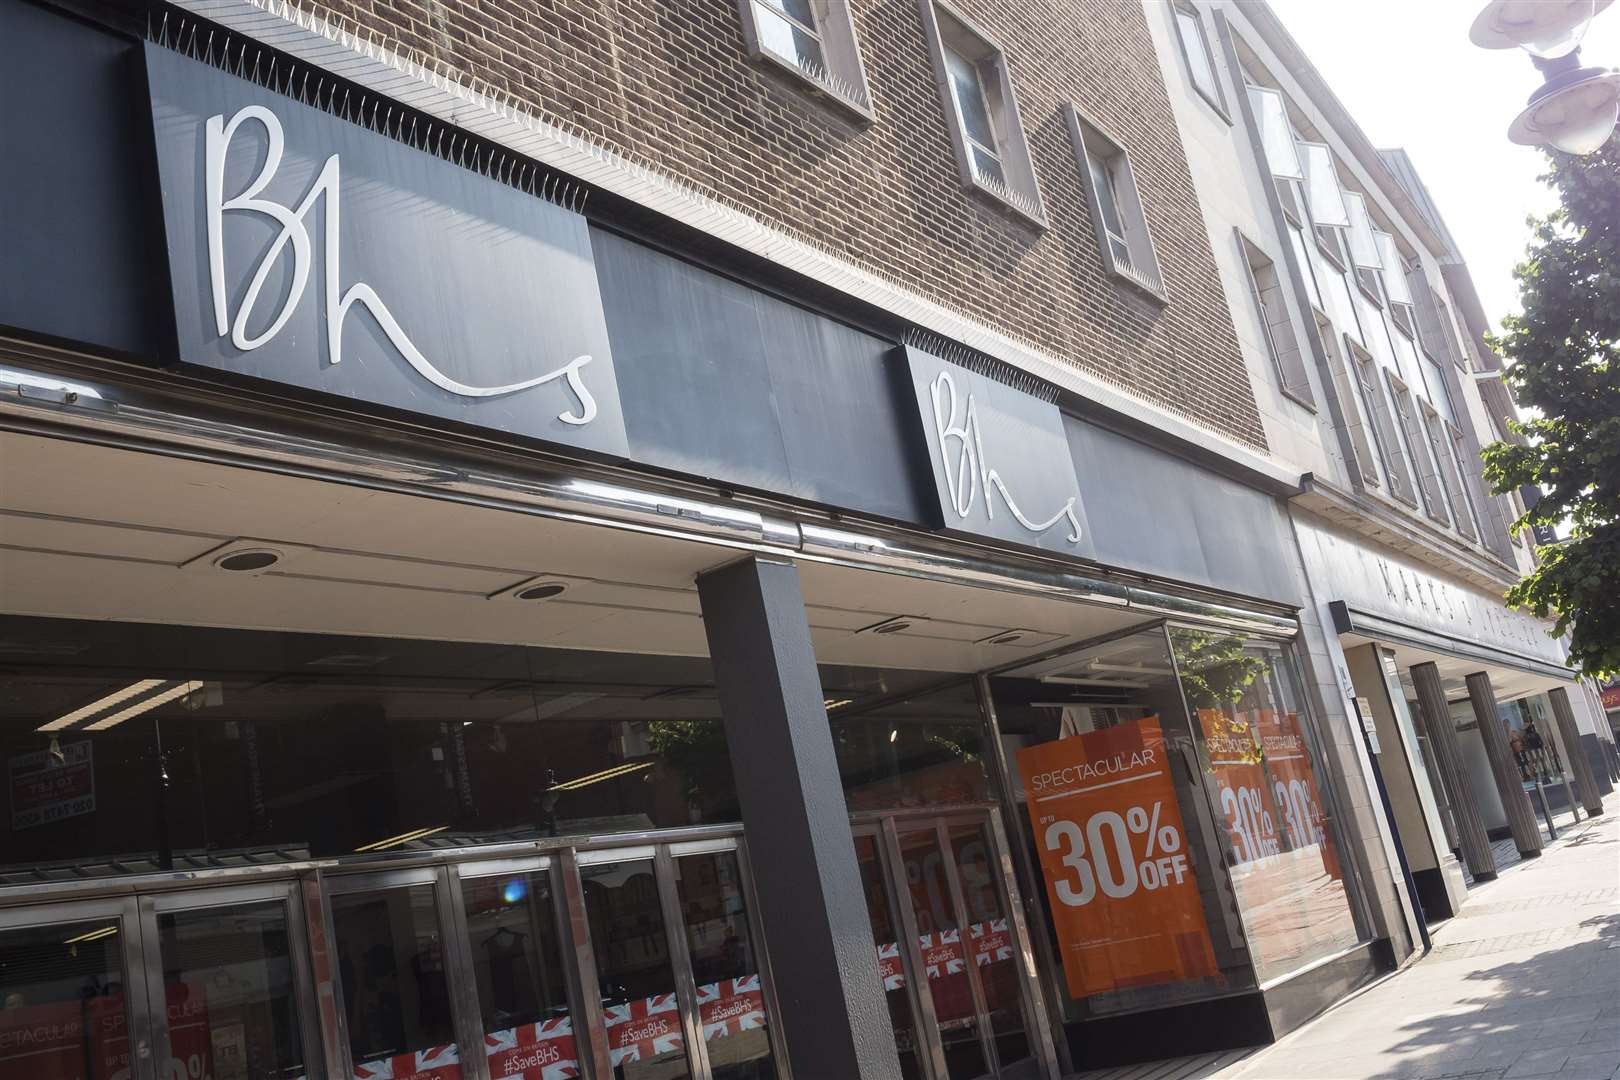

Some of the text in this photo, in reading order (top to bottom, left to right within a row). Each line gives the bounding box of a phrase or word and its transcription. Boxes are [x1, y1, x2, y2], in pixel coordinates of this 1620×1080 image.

[205, 105, 597, 425] Bhs
[930, 371, 1082, 543] Bhs
[1031, 749, 1157, 791] SPECTACULAR
[1044, 801, 1181, 908] 30%
[1138, 854, 1189, 890] OFF
[711, 998, 753, 1023] #SaveBHS
[621, 1019, 668, 1046] #SaveBHS
[503, 1045, 560, 1075] #SaveBHS
